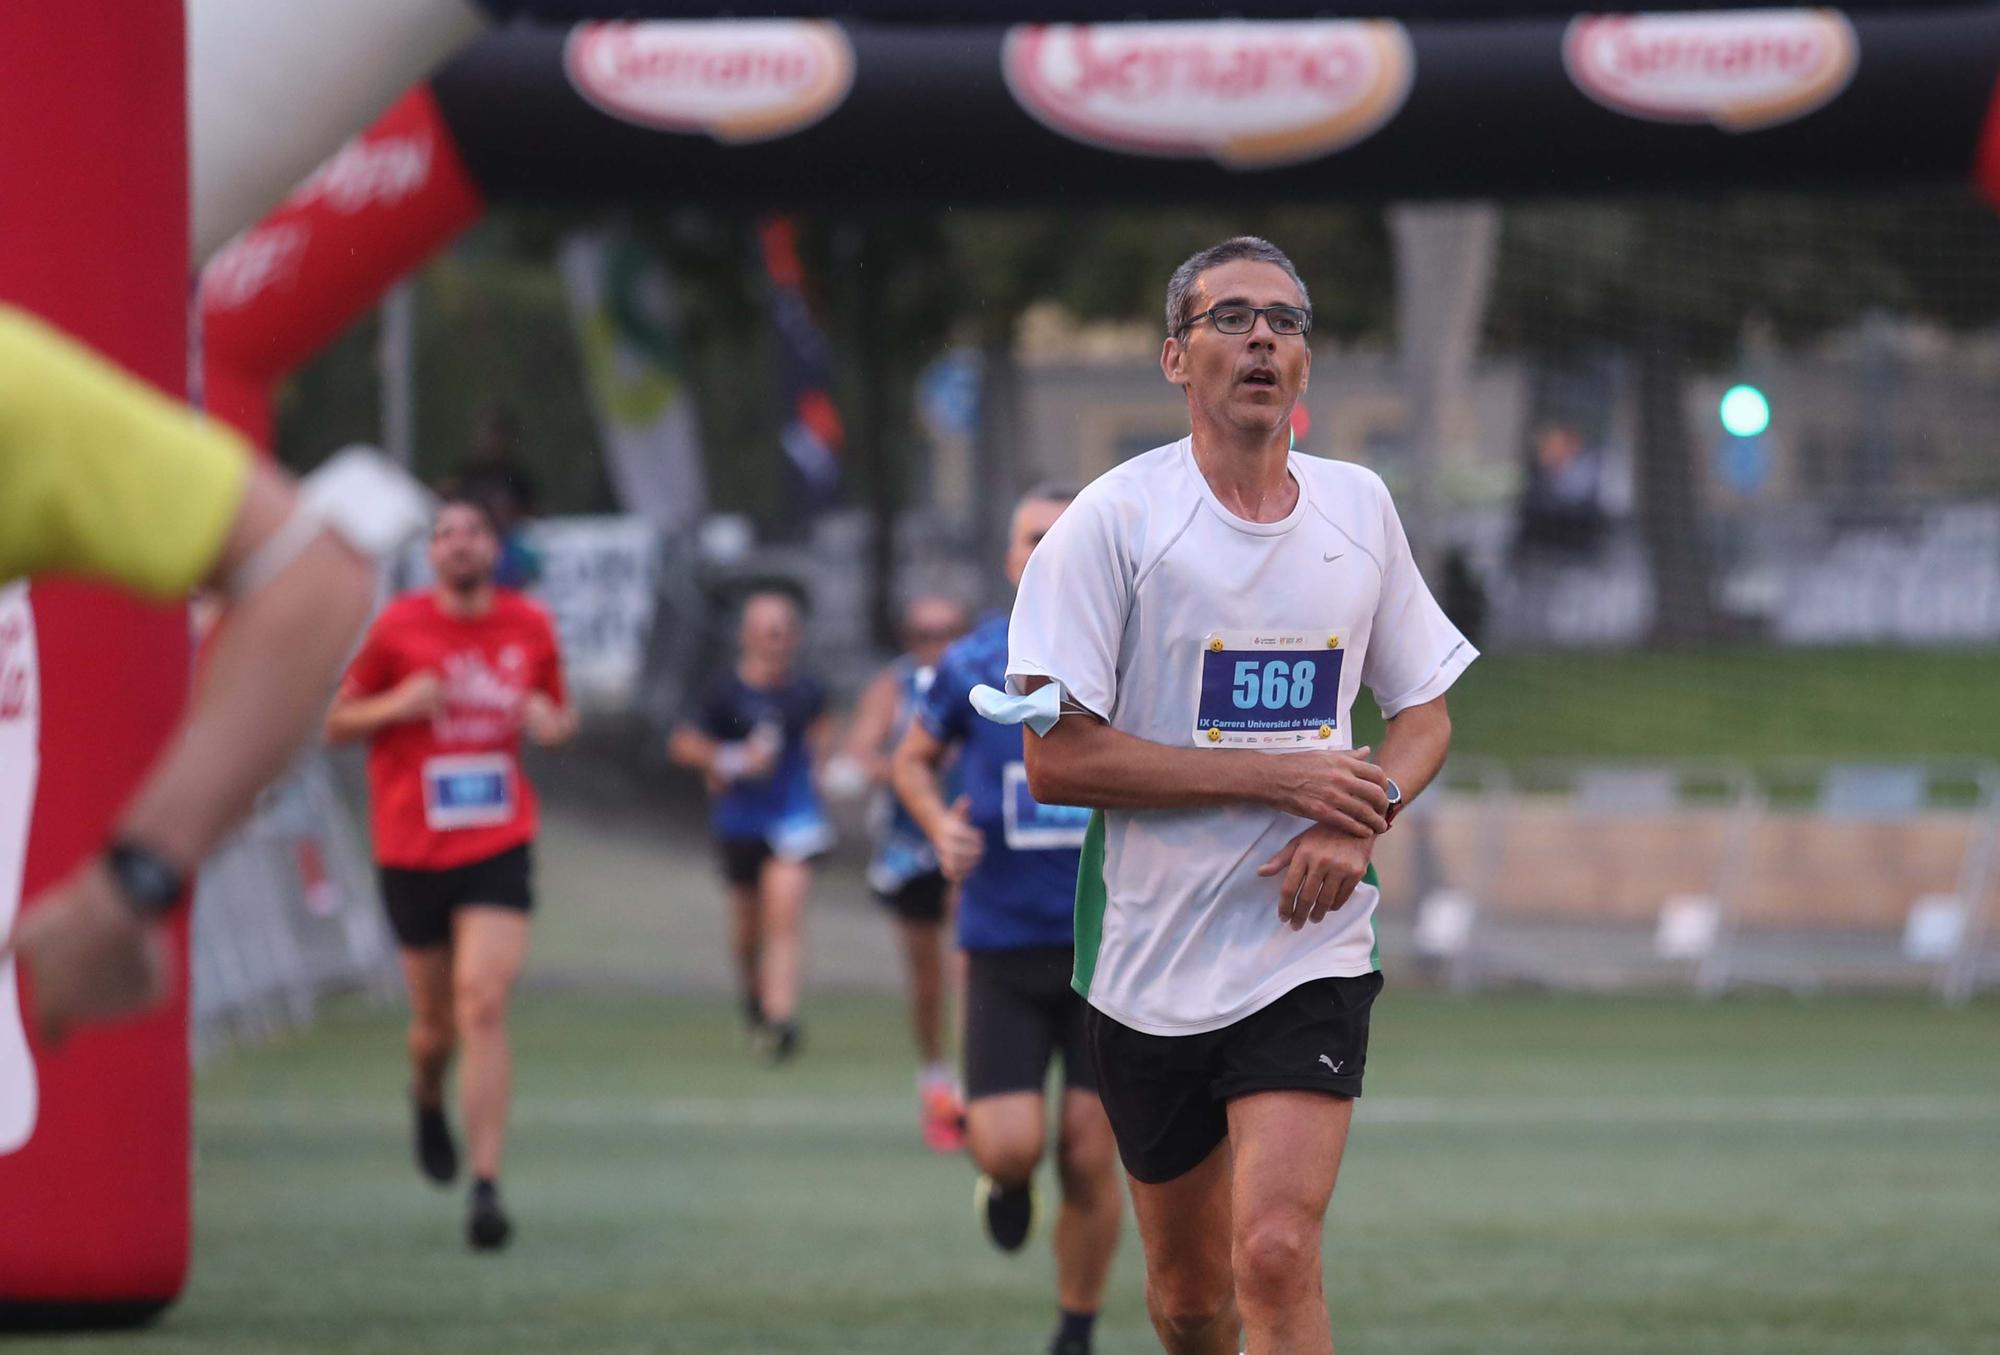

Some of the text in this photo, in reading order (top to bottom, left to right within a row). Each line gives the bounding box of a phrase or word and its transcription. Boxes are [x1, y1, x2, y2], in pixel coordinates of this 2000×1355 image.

[1232, 660, 1316, 710] 568
[1199, 718, 1210, 727] IX
[1212, 719, 1246, 728] Carrera
[1247, 720, 1291, 729] Universitat
[1291, 719, 1301, 728] de
